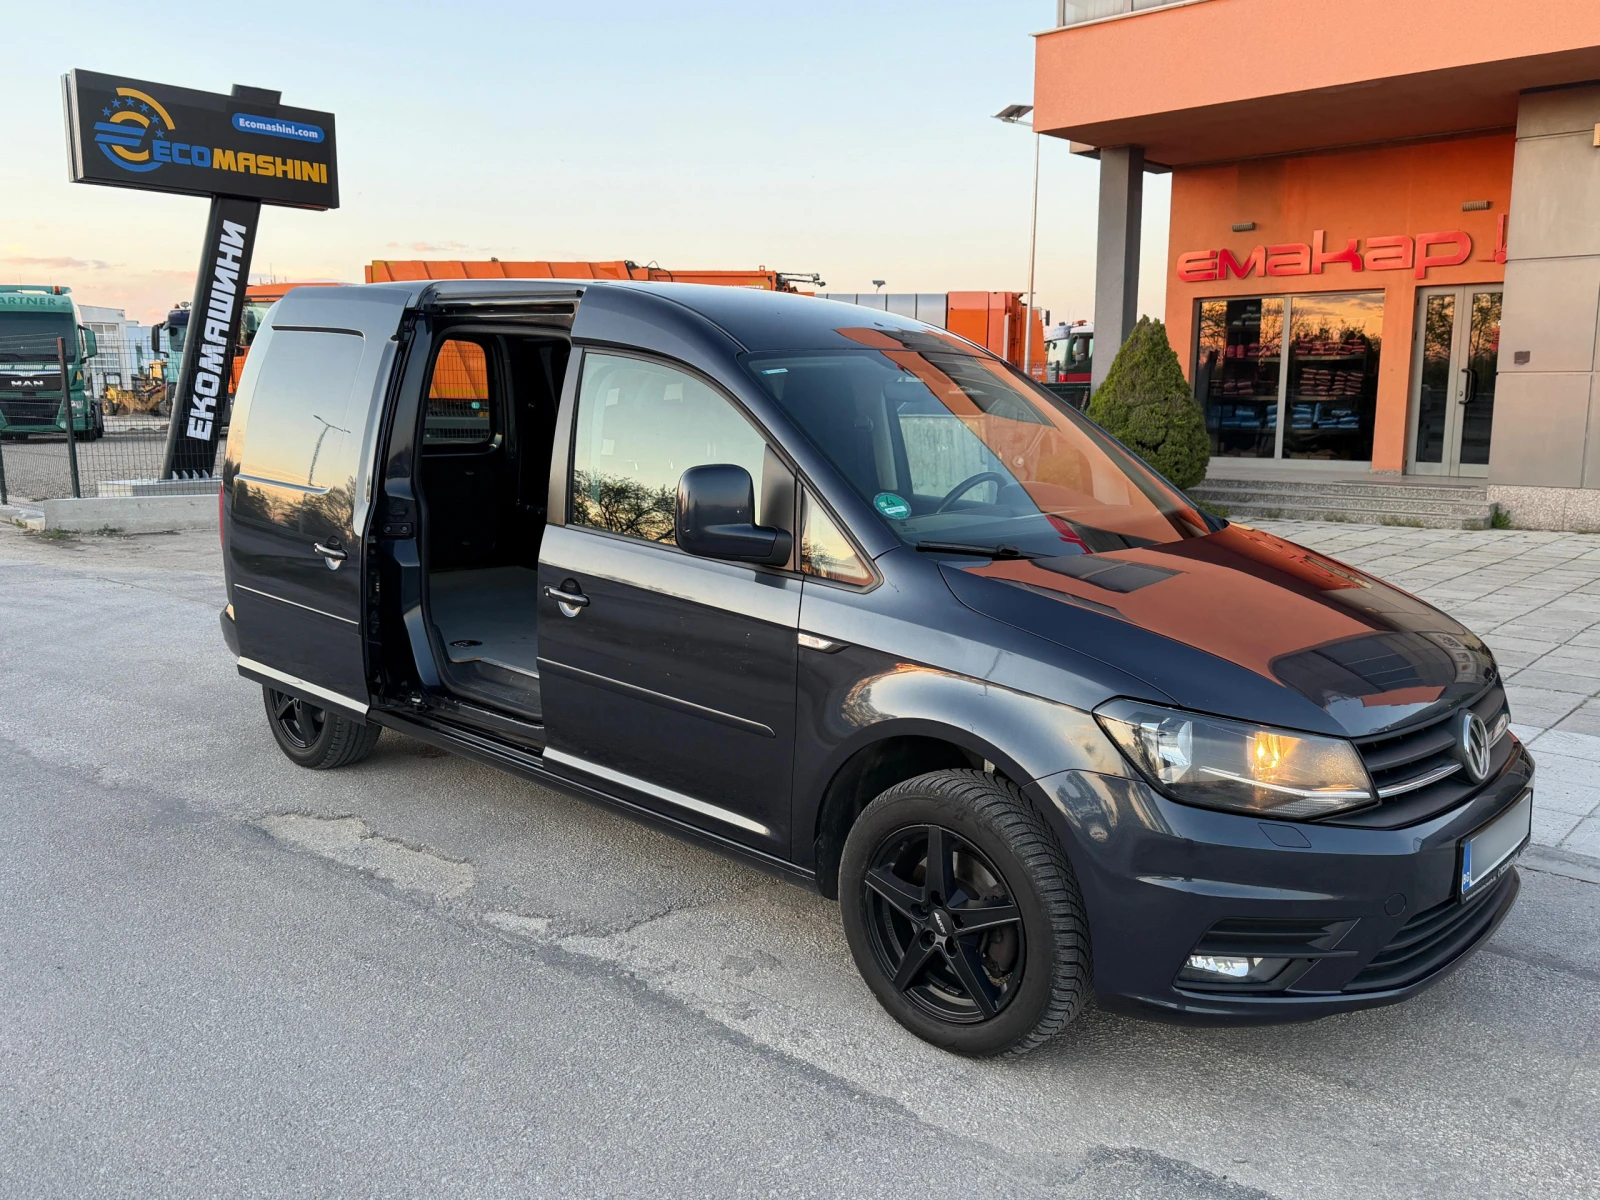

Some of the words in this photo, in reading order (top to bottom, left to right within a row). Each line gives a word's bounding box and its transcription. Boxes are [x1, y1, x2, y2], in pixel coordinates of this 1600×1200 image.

[238, 117, 319, 139] Ecomashini.com
[152, 139, 328, 184] ECOMASHINI
[186, 219, 247, 441] ЕКОМАШИНИ
